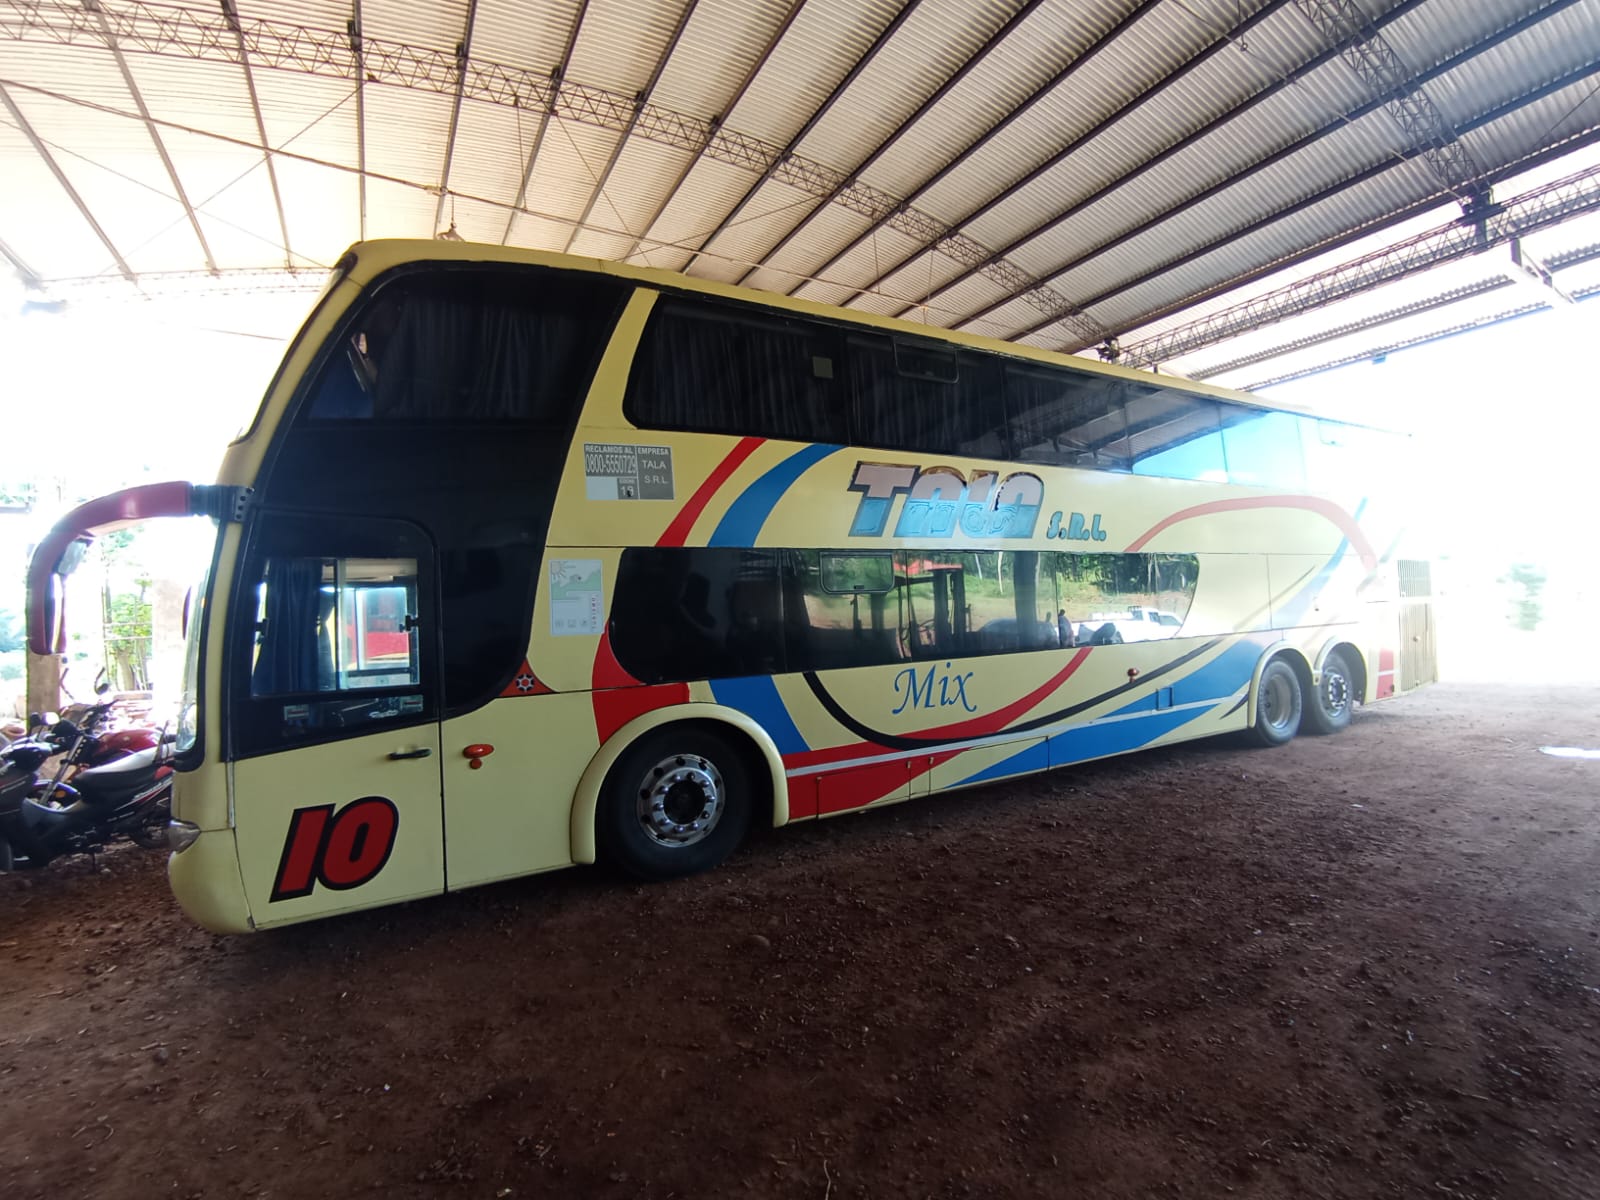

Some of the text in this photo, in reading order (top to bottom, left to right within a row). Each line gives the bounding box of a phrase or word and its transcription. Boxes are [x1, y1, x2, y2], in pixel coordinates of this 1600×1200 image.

[585, 445, 623, 454] RECLAMOS
[637, 447, 669, 456] EMPRESA
[641, 459, 667, 470] TALA
[892, 661, 977, 715] Mix
[269, 795, 400, 904] 10
